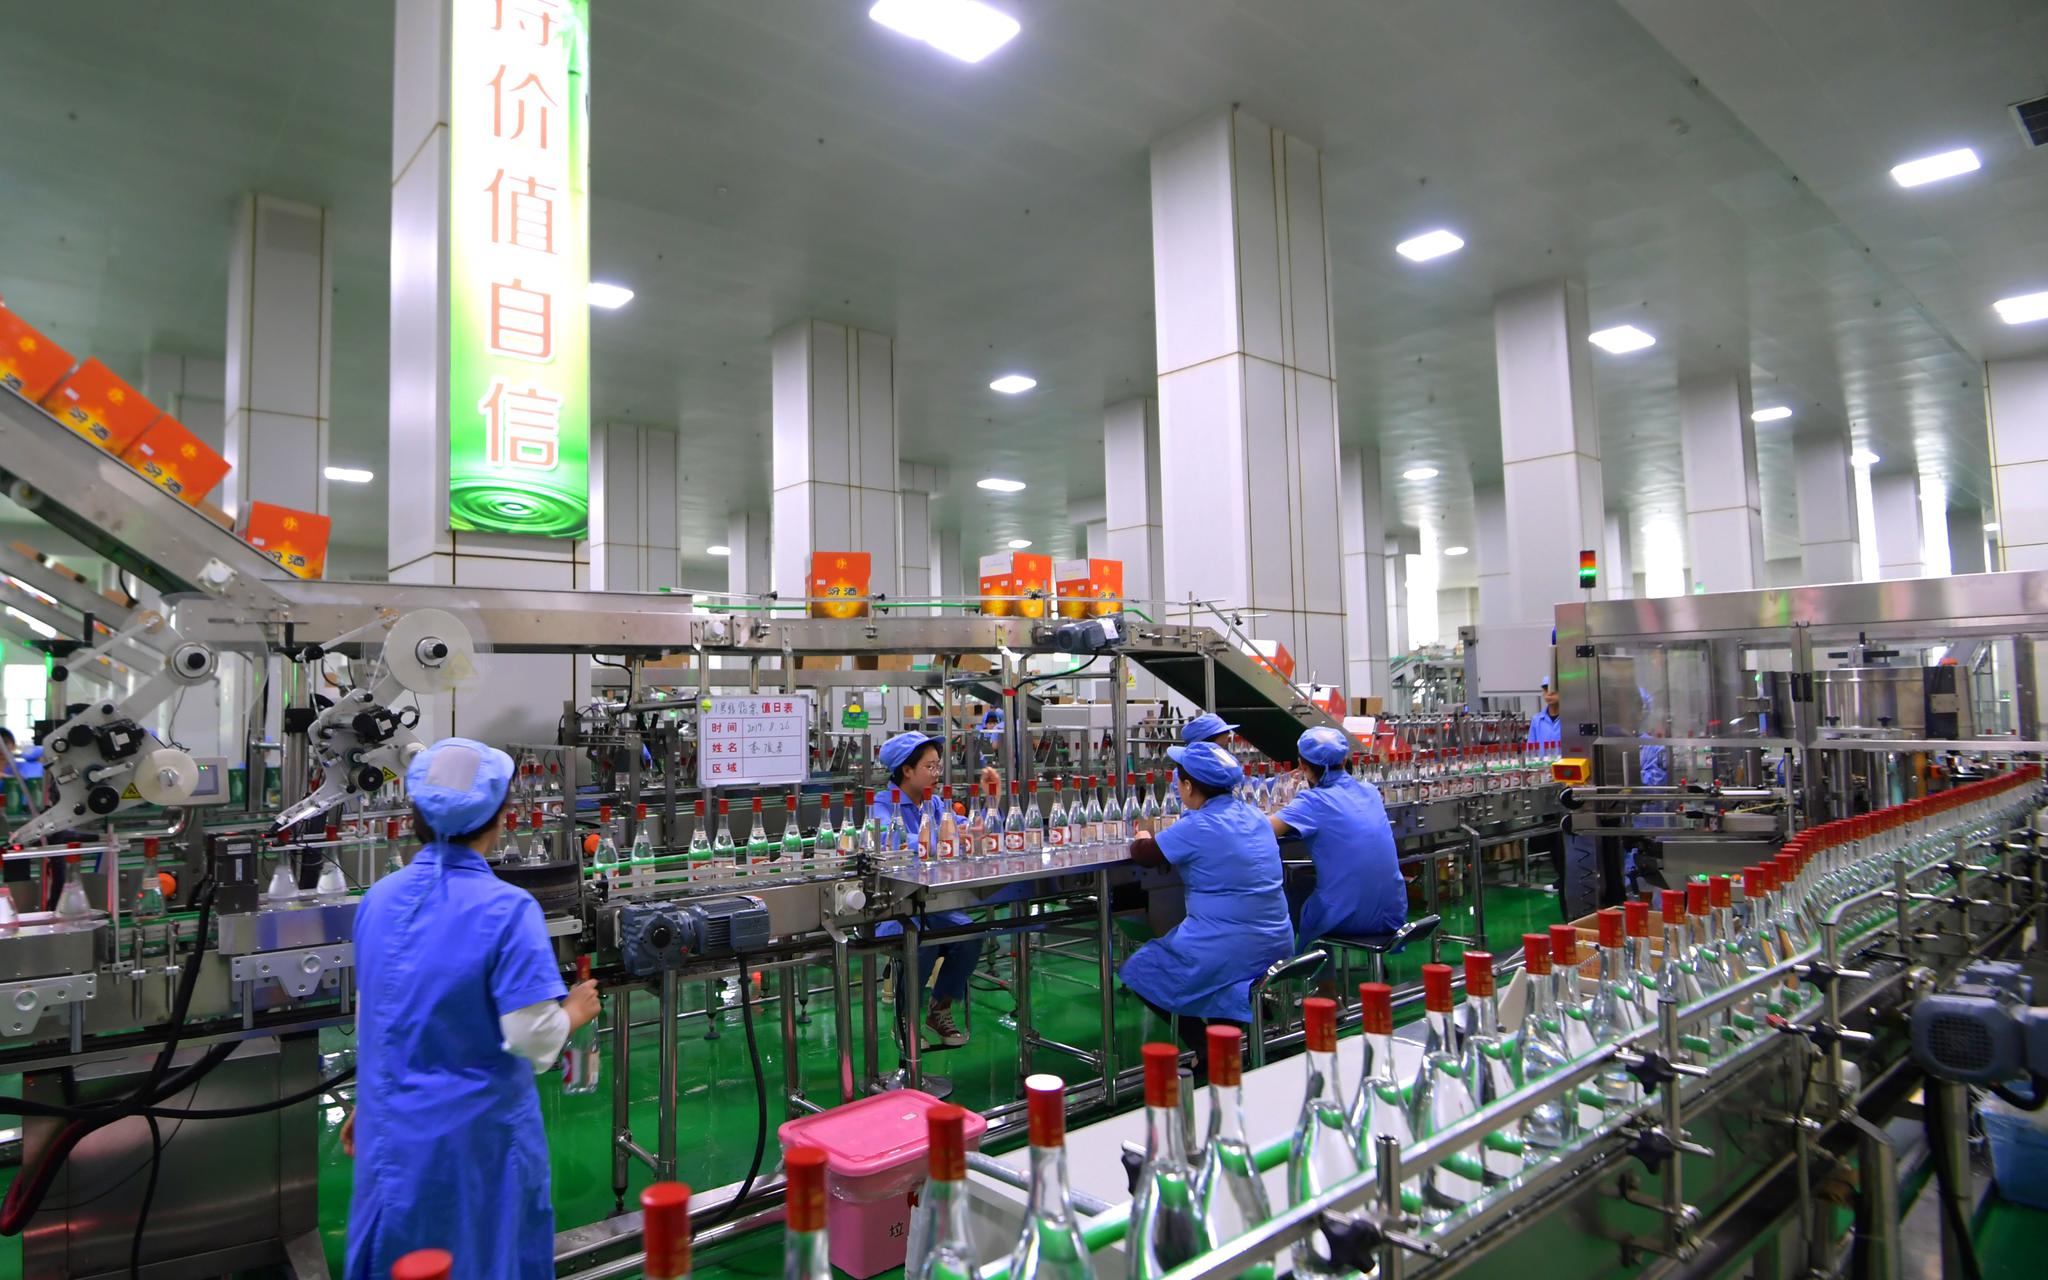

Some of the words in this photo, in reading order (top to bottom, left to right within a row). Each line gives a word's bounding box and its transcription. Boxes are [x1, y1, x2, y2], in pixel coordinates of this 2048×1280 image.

[761, 702, 793, 714] 值日表
[711, 722, 737, 733] 时间
[712, 742, 738, 753] 姓名
[712, 763, 737, 773] 区域
